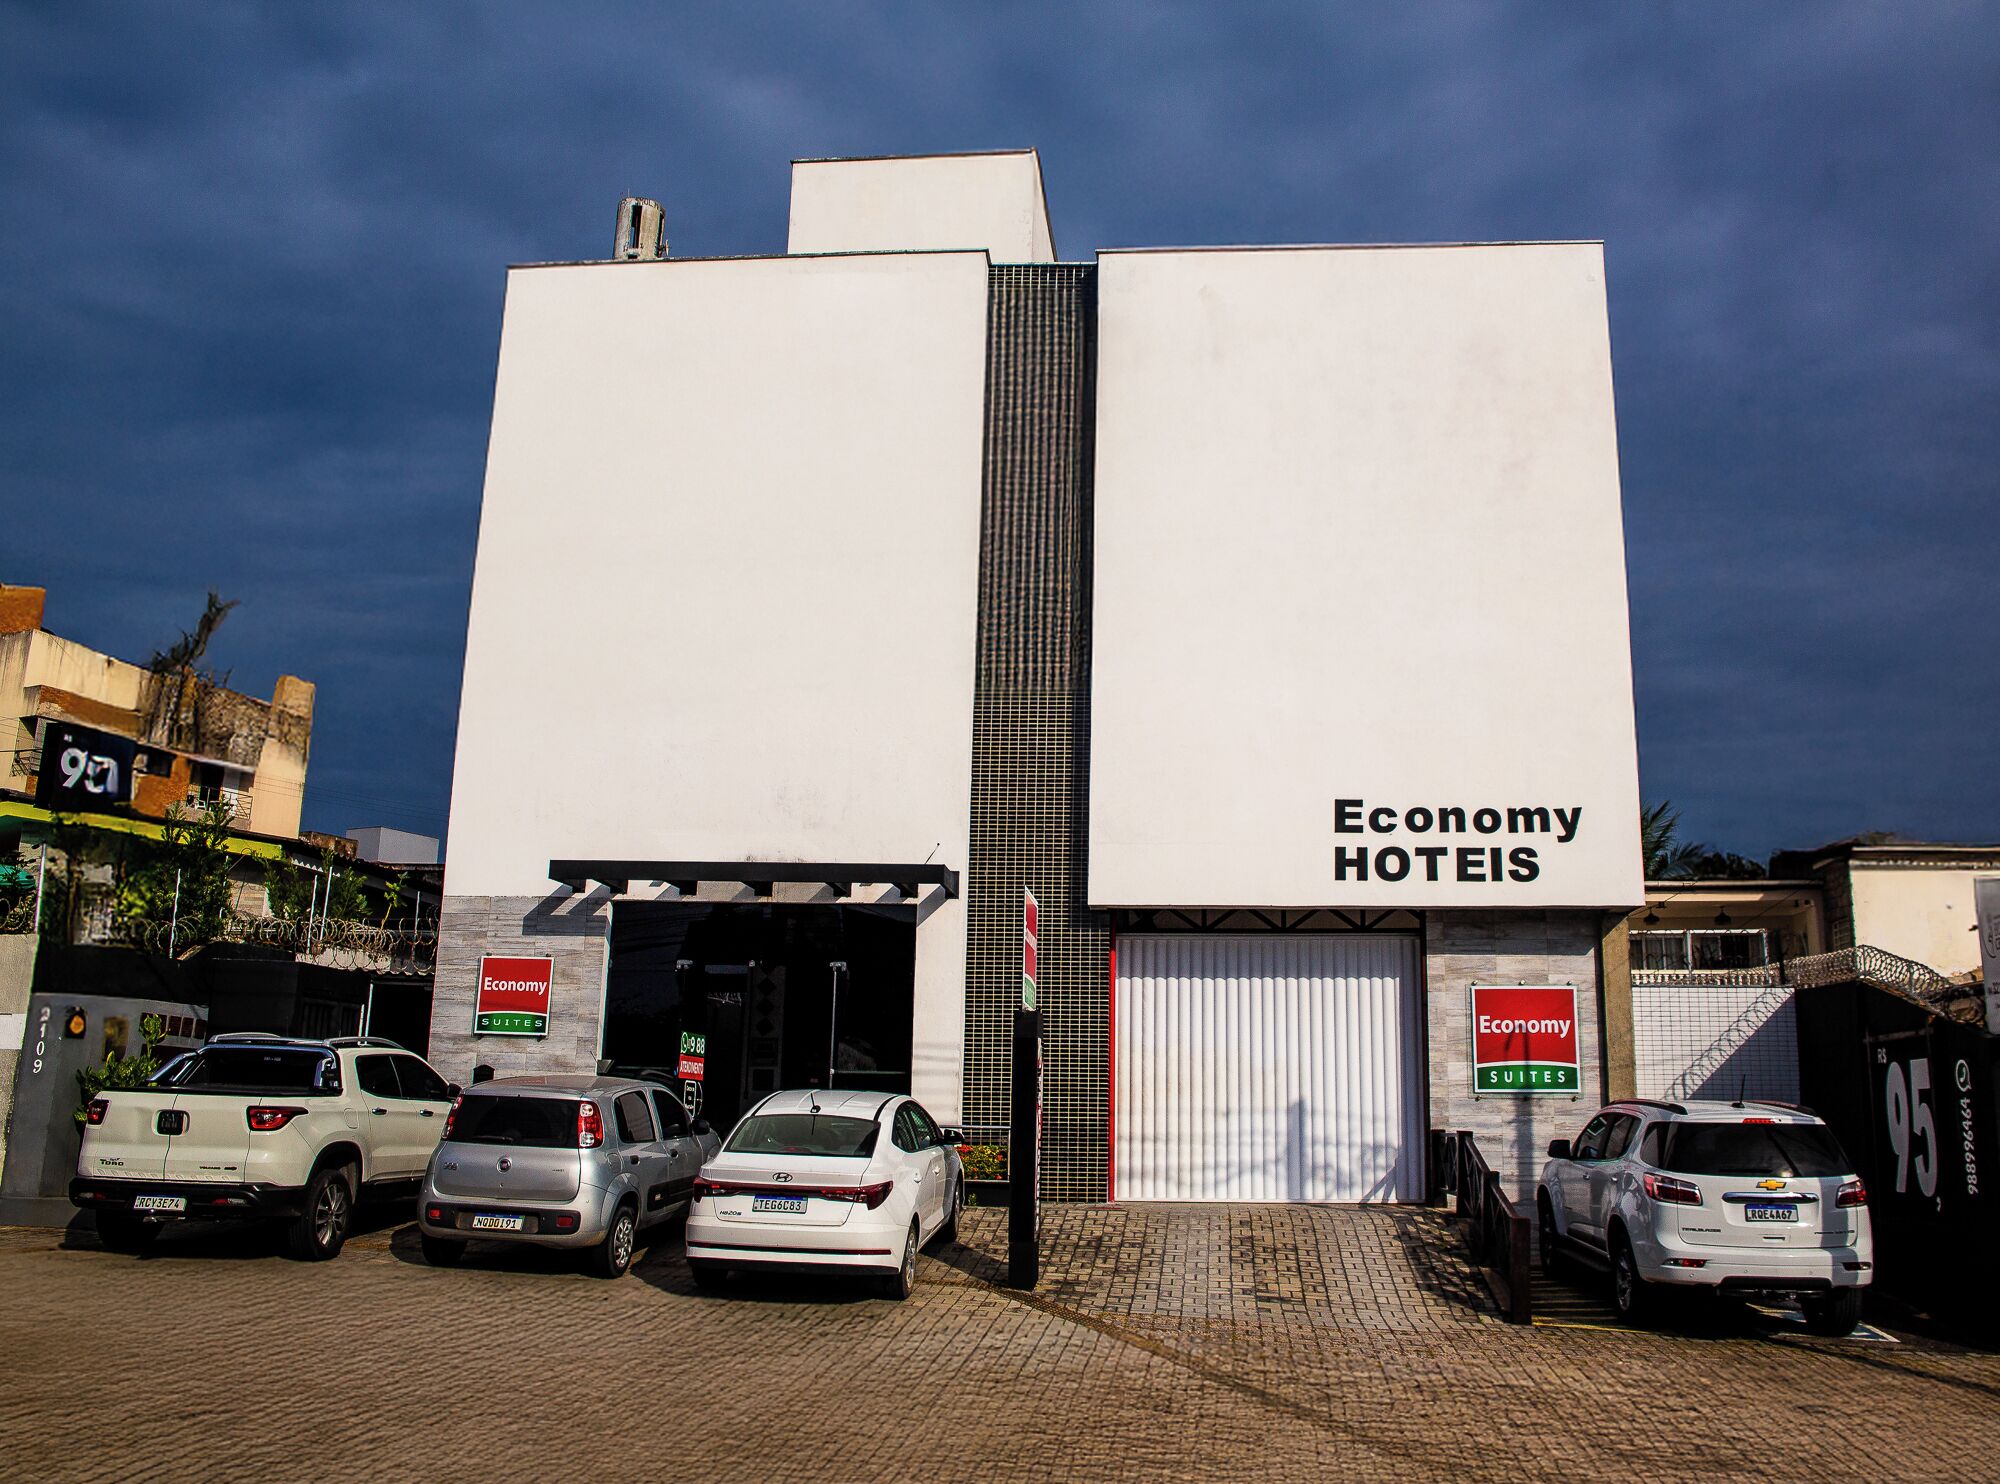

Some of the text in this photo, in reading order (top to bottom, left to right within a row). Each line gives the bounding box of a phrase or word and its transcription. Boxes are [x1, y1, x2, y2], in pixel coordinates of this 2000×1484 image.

[1334, 798, 1582, 843] Economy
[1334, 846, 1540, 882] HOTEIS
[483, 976, 547, 995] Economy
[481, 1018, 543, 1027] SUITES
[1479, 1015, 1571, 1038] Economy
[32, 1006, 50, 1074] 2109
[1490, 1070, 1566, 1083] SUITES
[759, 1199, 802, 1211] TEG6C83
[1751, 1209, 1793, 1220] RQE4A67
